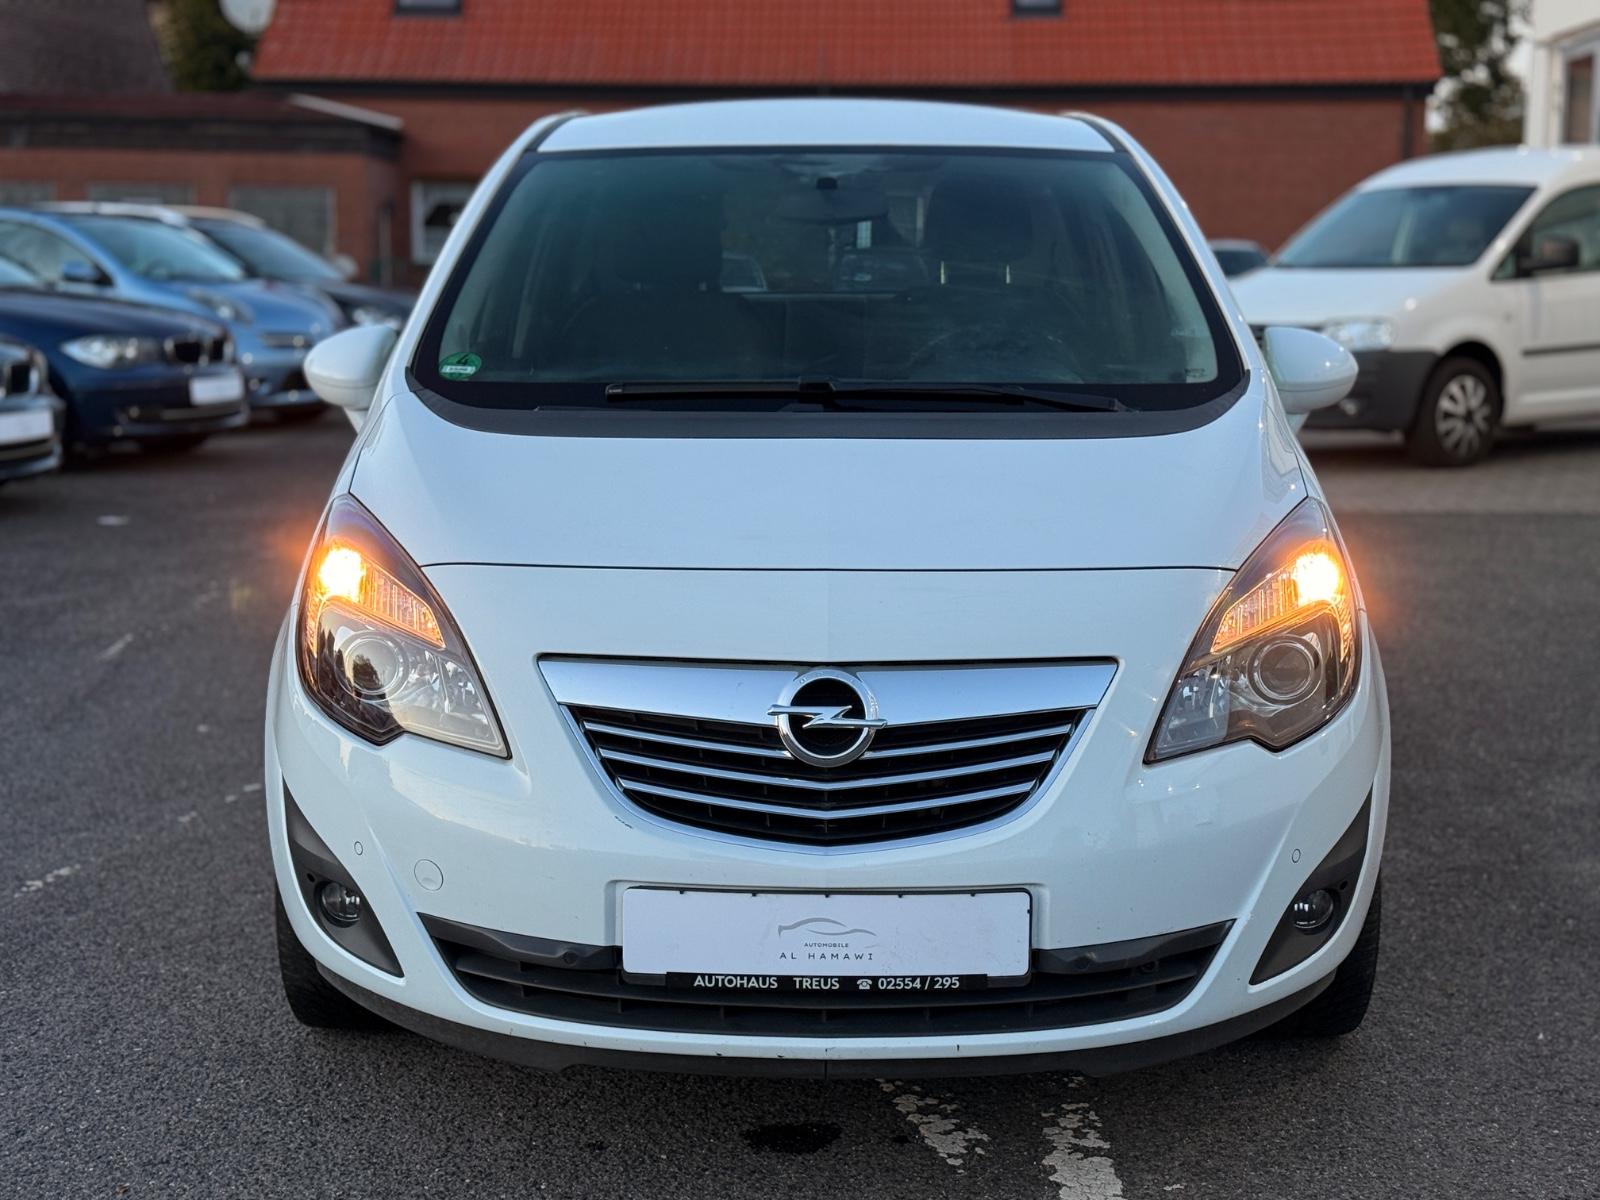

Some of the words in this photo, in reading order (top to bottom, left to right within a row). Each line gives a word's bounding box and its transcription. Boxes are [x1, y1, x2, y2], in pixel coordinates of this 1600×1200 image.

[456, 353, 468, 365] 4
[804, 941, 849, 949] AUTOMOBILE
[779, 951, 798, 961] AL
[808, 952, 873, 961] HAMAWI
[692, 975, 778, 989] AUTOHAUS
[793, 977, 840, 990] TREUS
[877, 977, 922, 990] 02554
[933, 977, 960, 990] 295
